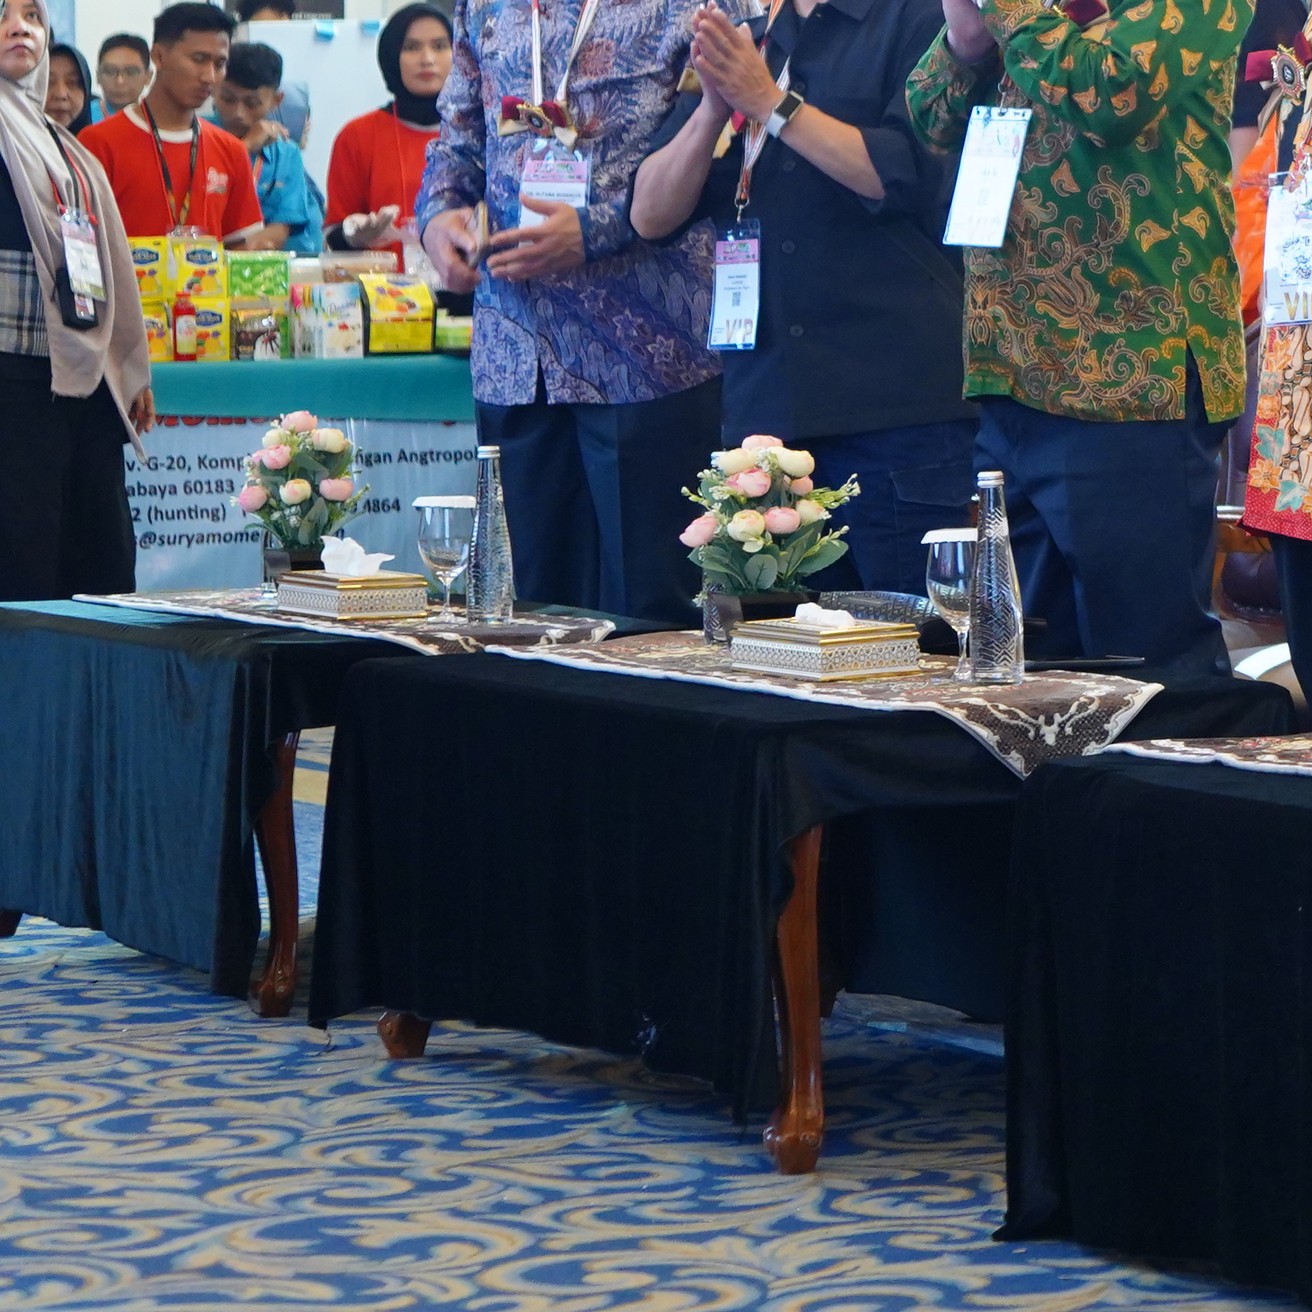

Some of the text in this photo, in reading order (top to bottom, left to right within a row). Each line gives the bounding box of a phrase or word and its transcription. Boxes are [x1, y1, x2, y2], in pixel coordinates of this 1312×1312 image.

[725, 318, 753, 344] VIP
[147, 454, 191, 473] G-20,
[197, 453, 249, 472] Komp
[397, 446, 478, 466] Angtropol
[126, 478, 235, 500] abaya 60183
[147, 503, 227, 525] (hunting)
